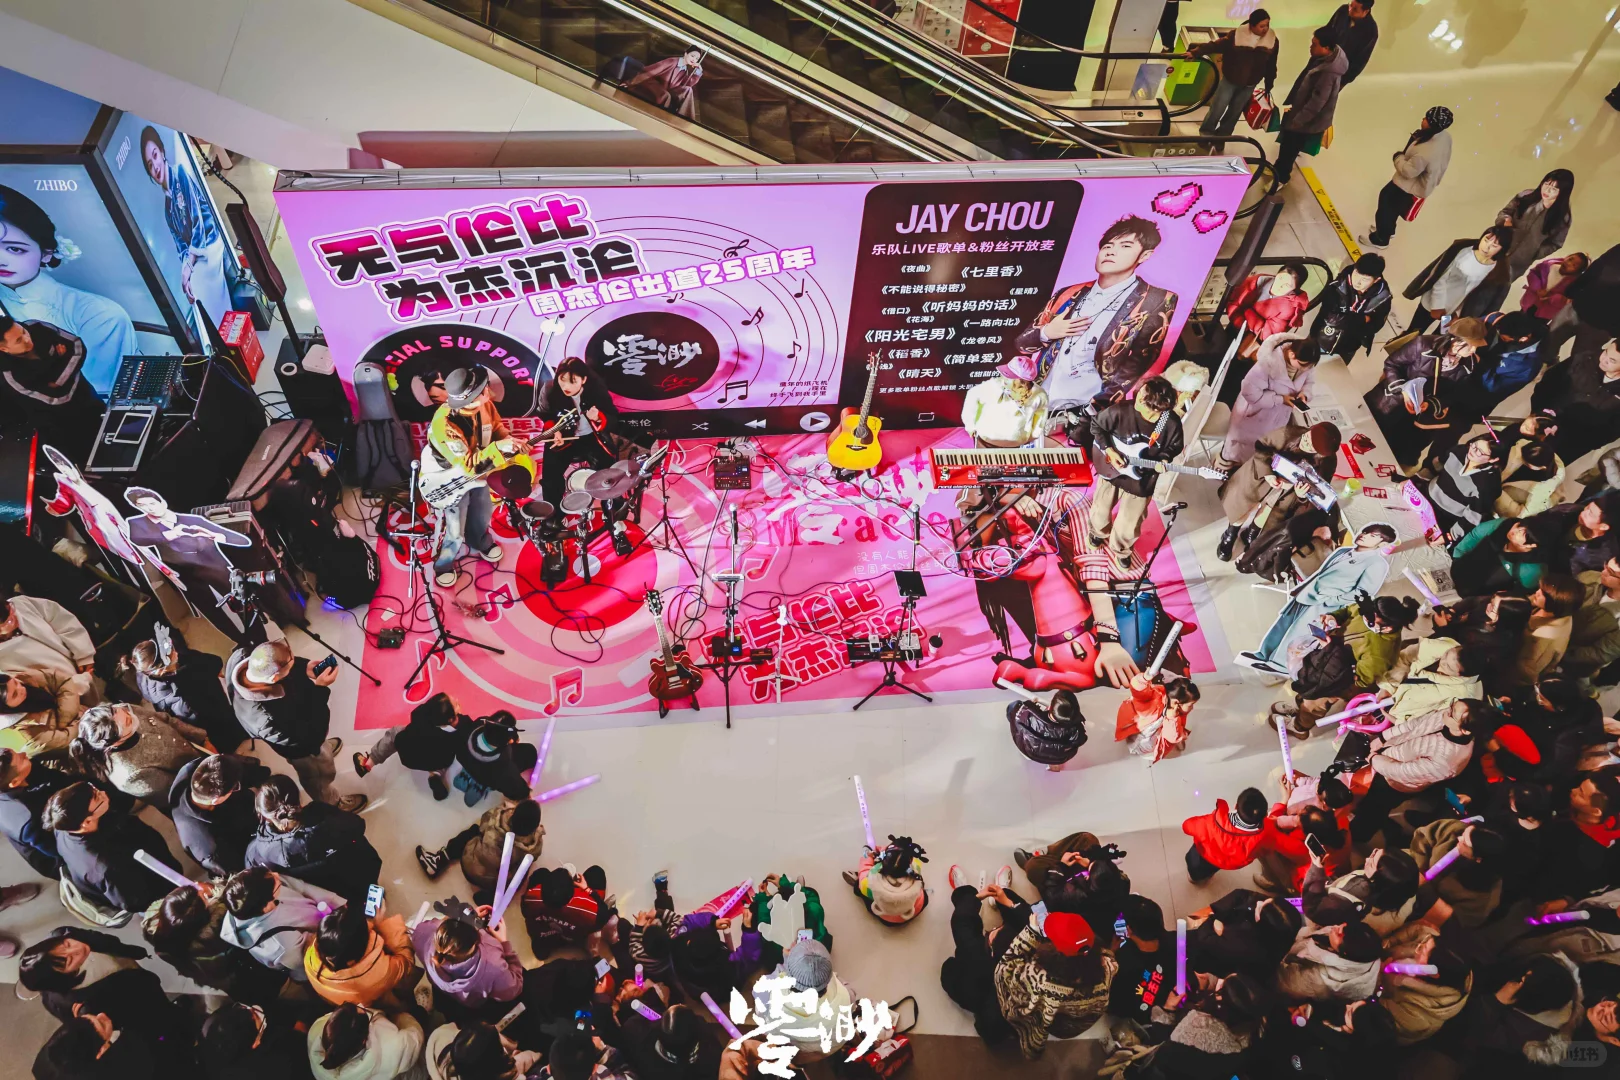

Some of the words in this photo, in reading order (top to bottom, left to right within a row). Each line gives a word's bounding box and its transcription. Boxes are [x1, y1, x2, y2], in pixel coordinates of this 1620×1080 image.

[115, 135, 131, 170] ZHIBO
[33, 179, 78, 192] ZHIBO
[895, 203, 960, 234] JAY
[964, 201, 1055, 231] CHOU
[318, 198, 591, 282] 无与伦比
[871, 239, 1056, 256] 乐队LIVE歌单&粉丝开放麦
[900, 264, 932, 273] 《夜曲》
[960, 265, 1023, 278] 《七里香》
[378, 239, 641, 318] 为杰沉沦
[526, 246, 816, 317] 周杰伦出道25周年
[1009, 287, 1039, 296] 《星晴》
[881, 306, 911, 315] 《借口》
[921, 299, 1018, 313] 《听妈妈的话》
[905, 315, 935, 324] 《花海》
[963, 317, 1021, 328] 《一路向北》
[864, 327, 957, 343] 《阳光宅男》
[960, 335, 1003, 345] 《龙卷风》
[887, 348, 931, 360] 《稻香》
[943, 353, 1003, 365] 《简单爱》
[439, 335, 534, 387] SUPPORT
[898, 368, 943, 379] 《晴天》
